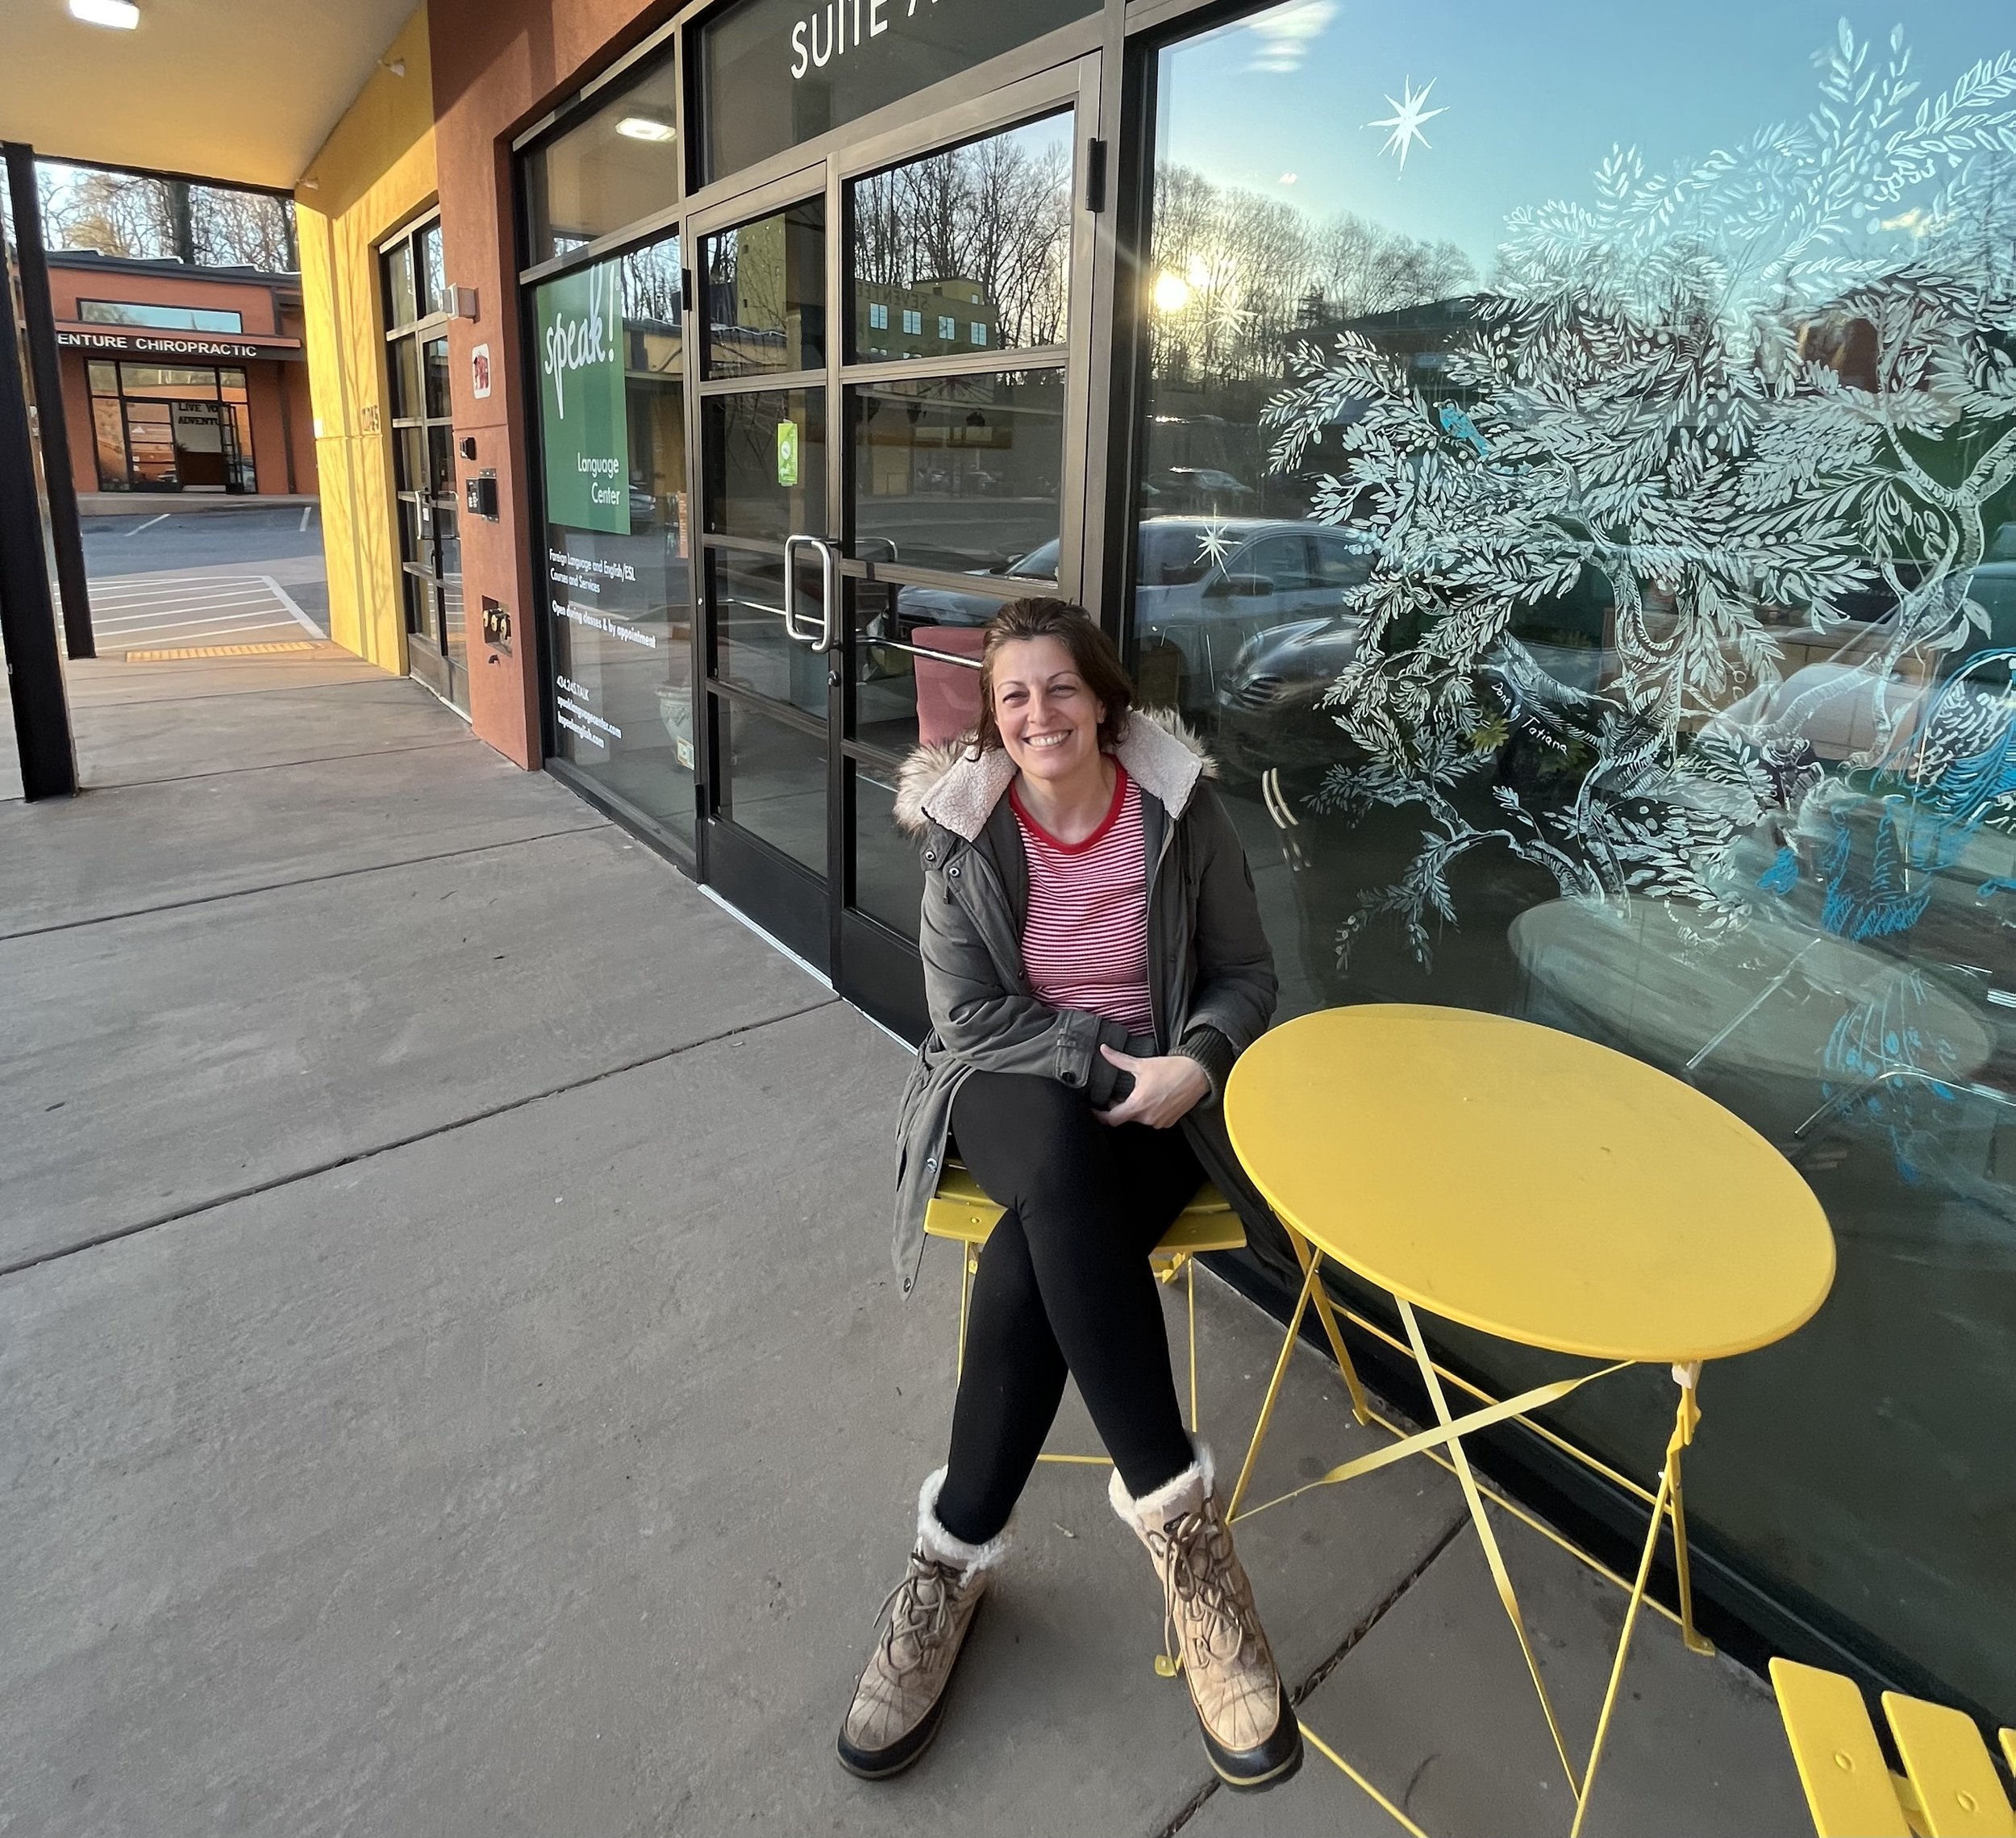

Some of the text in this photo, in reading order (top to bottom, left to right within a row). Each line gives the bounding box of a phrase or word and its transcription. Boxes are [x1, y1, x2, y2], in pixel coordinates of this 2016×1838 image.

[790, 0, 888, 79] SUITE
[57, 333, 257, 356] ENTURE CHIROPRACTIC
[178, 404, 202, 412] LIVE
[577, 452, 619, 479] Language
[591, 481, 620, 505] Center
[549, 548, 567, 566] Foreign
[567, 552, 591, 572] Language
[592, 560, 603, 573] and
[550, 567, 600, 593] Courses and Services
[552, 599, 565, 616] Open
[567, 604, 582, 624] during
[583, 611, 602, 629] classes
[608, 619, 616, 637] by
[617, 627, 656, 648] appointment
[1491, 681, 1512, 706] Done
[1521, 714, 1568, 756] Tatiana
